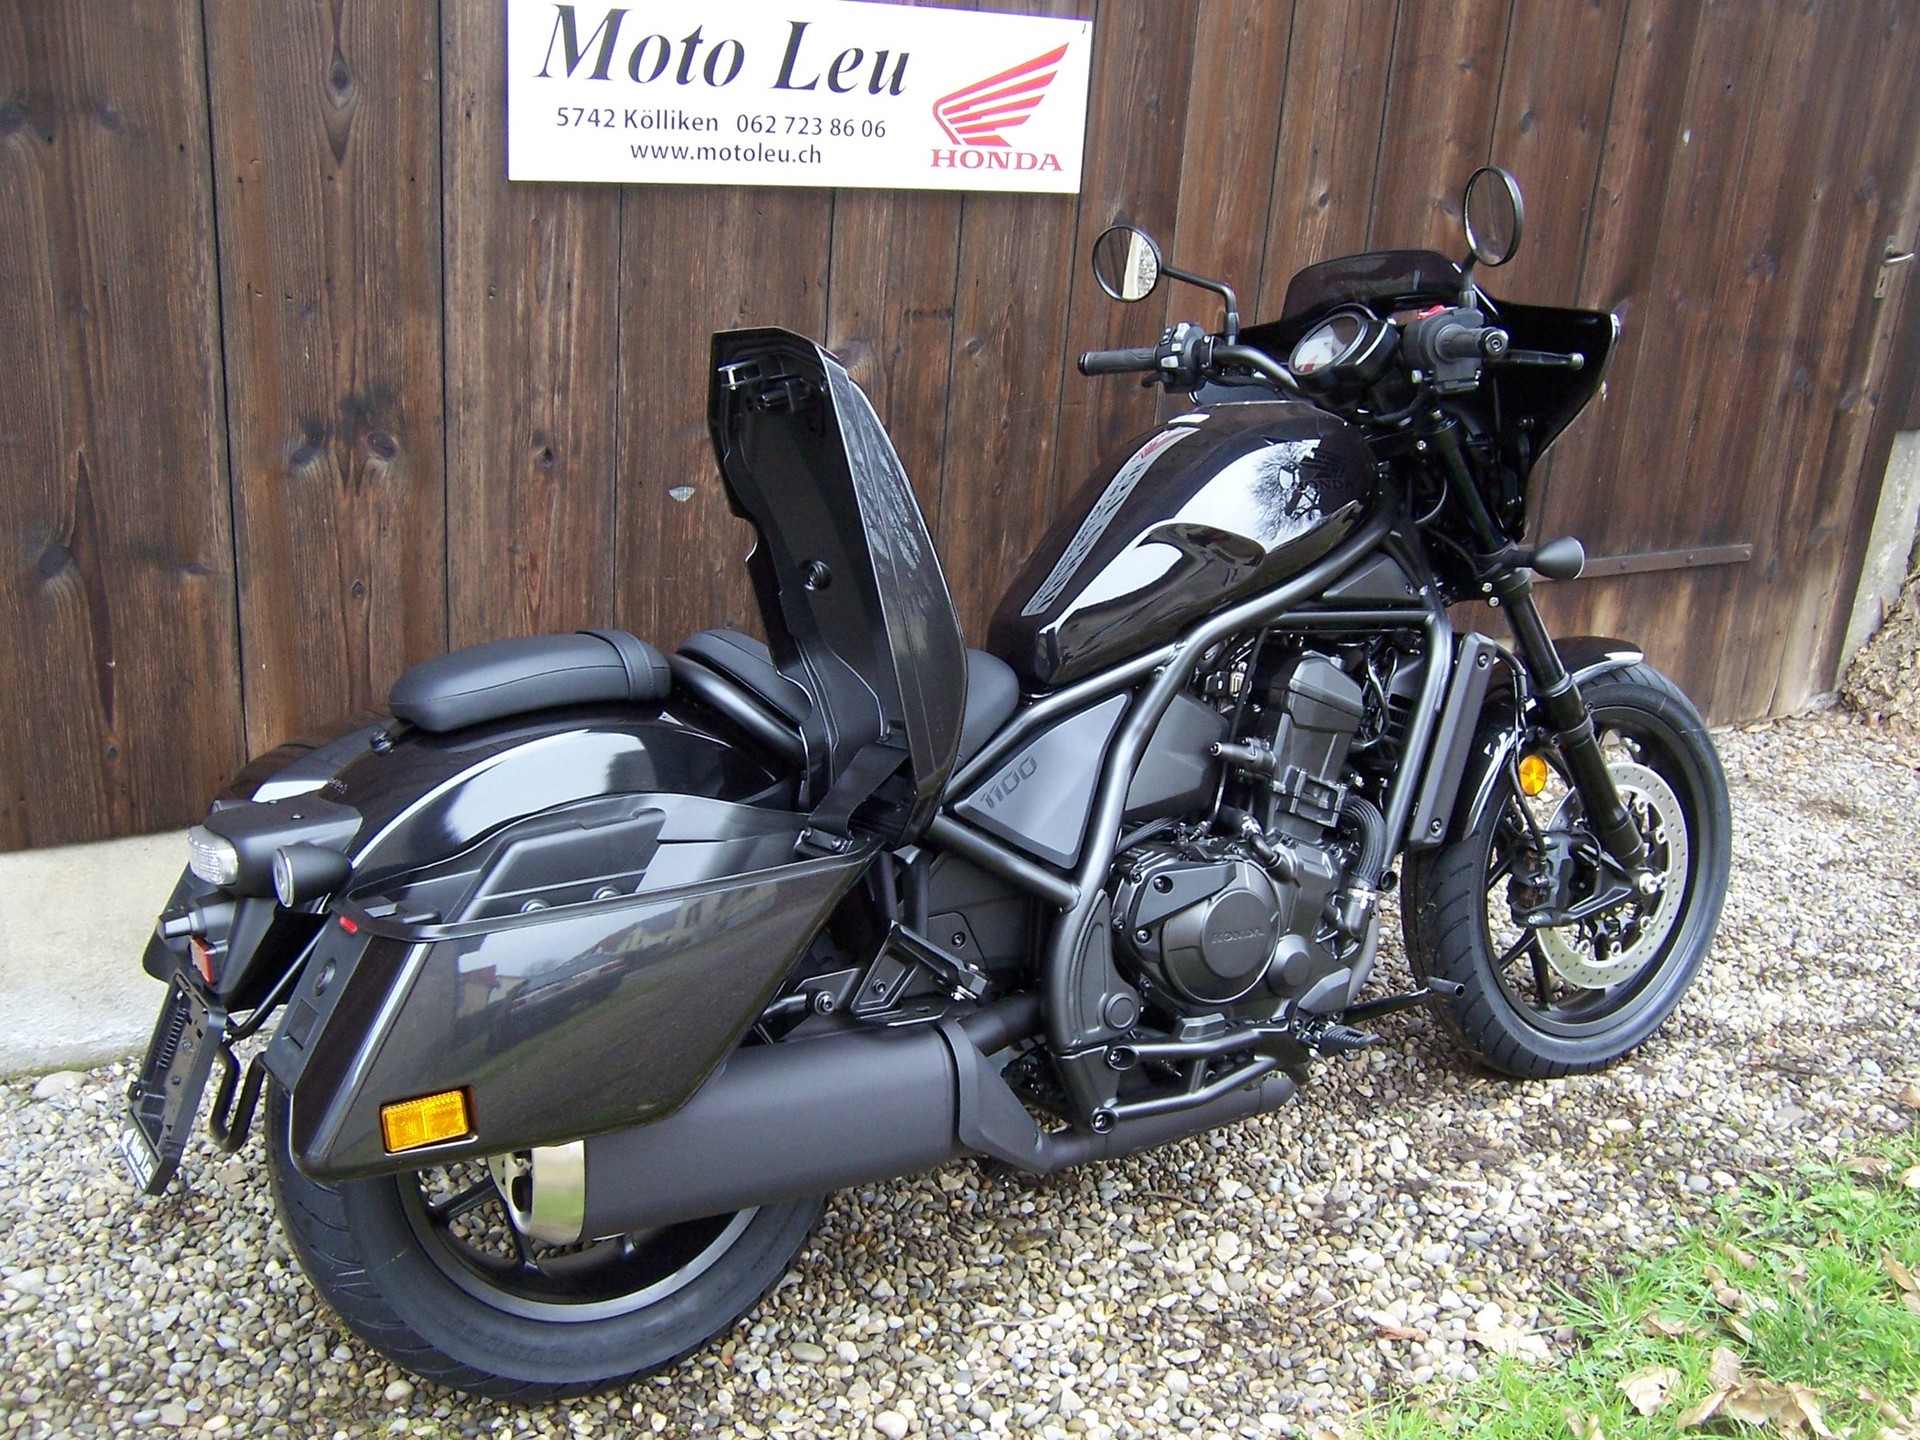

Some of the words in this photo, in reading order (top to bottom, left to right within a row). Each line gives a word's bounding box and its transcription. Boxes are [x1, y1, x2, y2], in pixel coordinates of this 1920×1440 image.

[534, 4, 746, 88] Moto
[770, 20, 910, 96] Leu
[556, 107, 616, 129] 5742
[624, 109, 719, 133] Kölliken
[736, 114, 777, 134] 062
[785, 116, 823, 137] 723
[830, 118, 856, 138] 86
[861, 119, 887, 139] 06
[630, 143, 822, 165] www.motoleu.ch
[930, 148, 1064, 172] HONDA
[980, 755, 1038, 809] 1100
